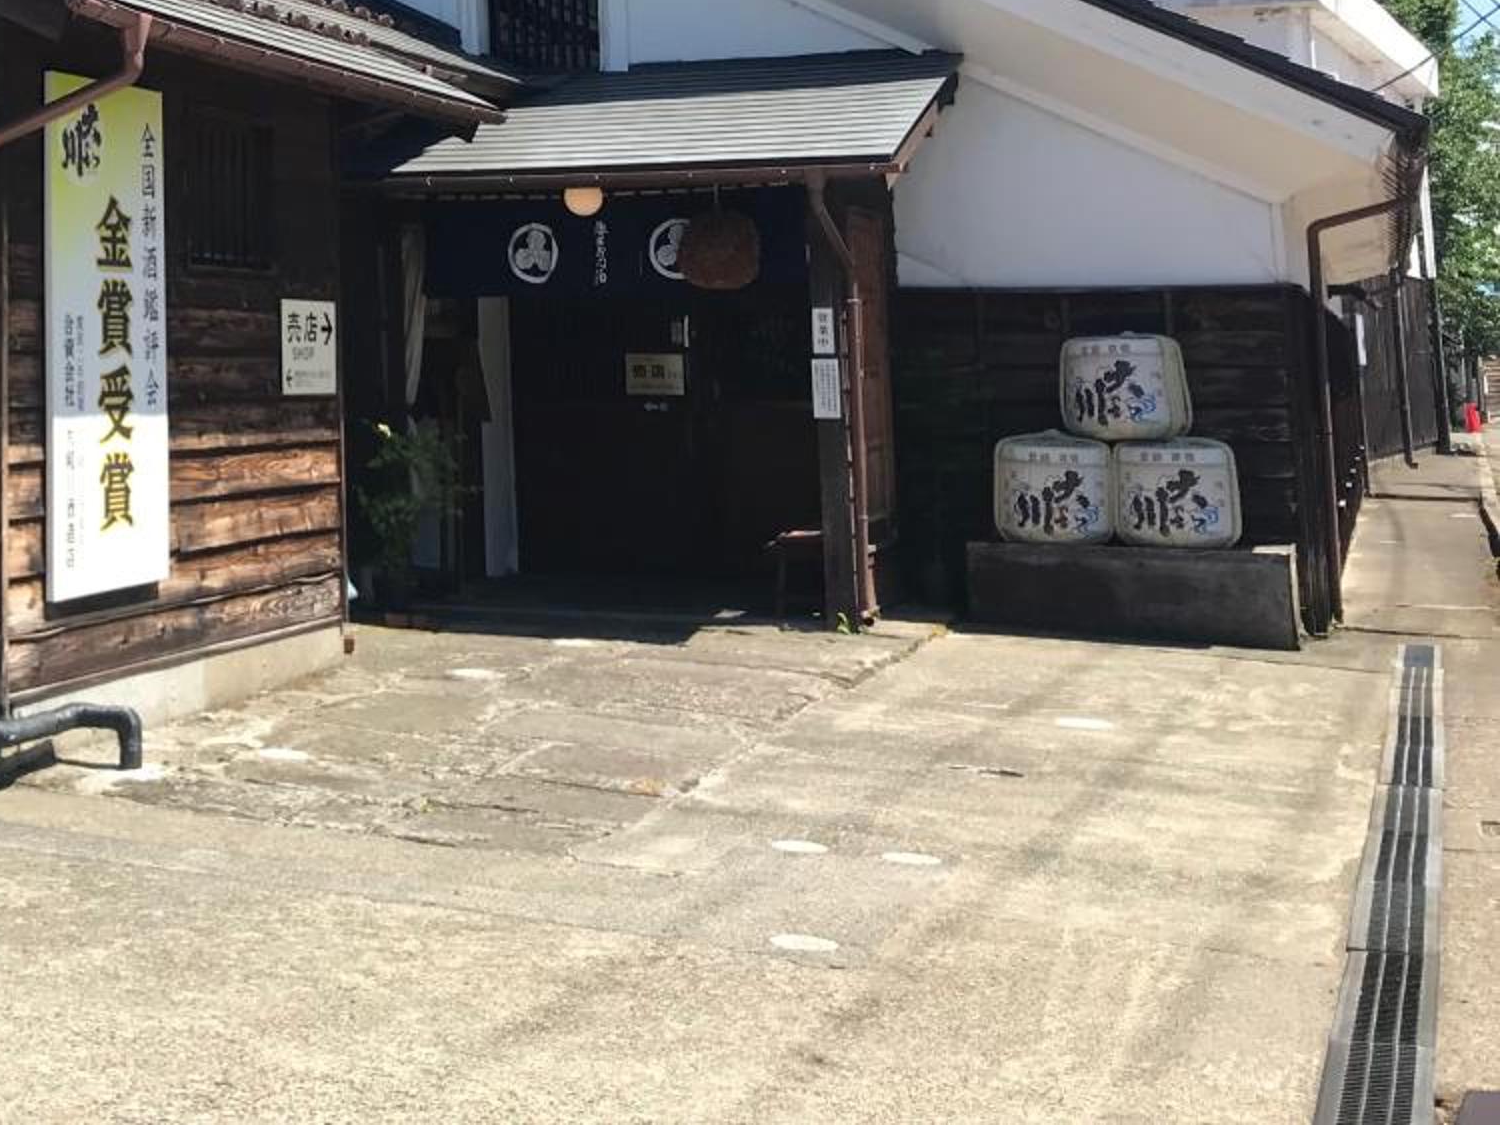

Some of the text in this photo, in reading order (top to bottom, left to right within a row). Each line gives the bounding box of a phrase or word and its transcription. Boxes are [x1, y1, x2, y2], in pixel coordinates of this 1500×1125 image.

[95, 196, 135, 531] 金賞受賞
[287, 311, 318, 344] 売店
